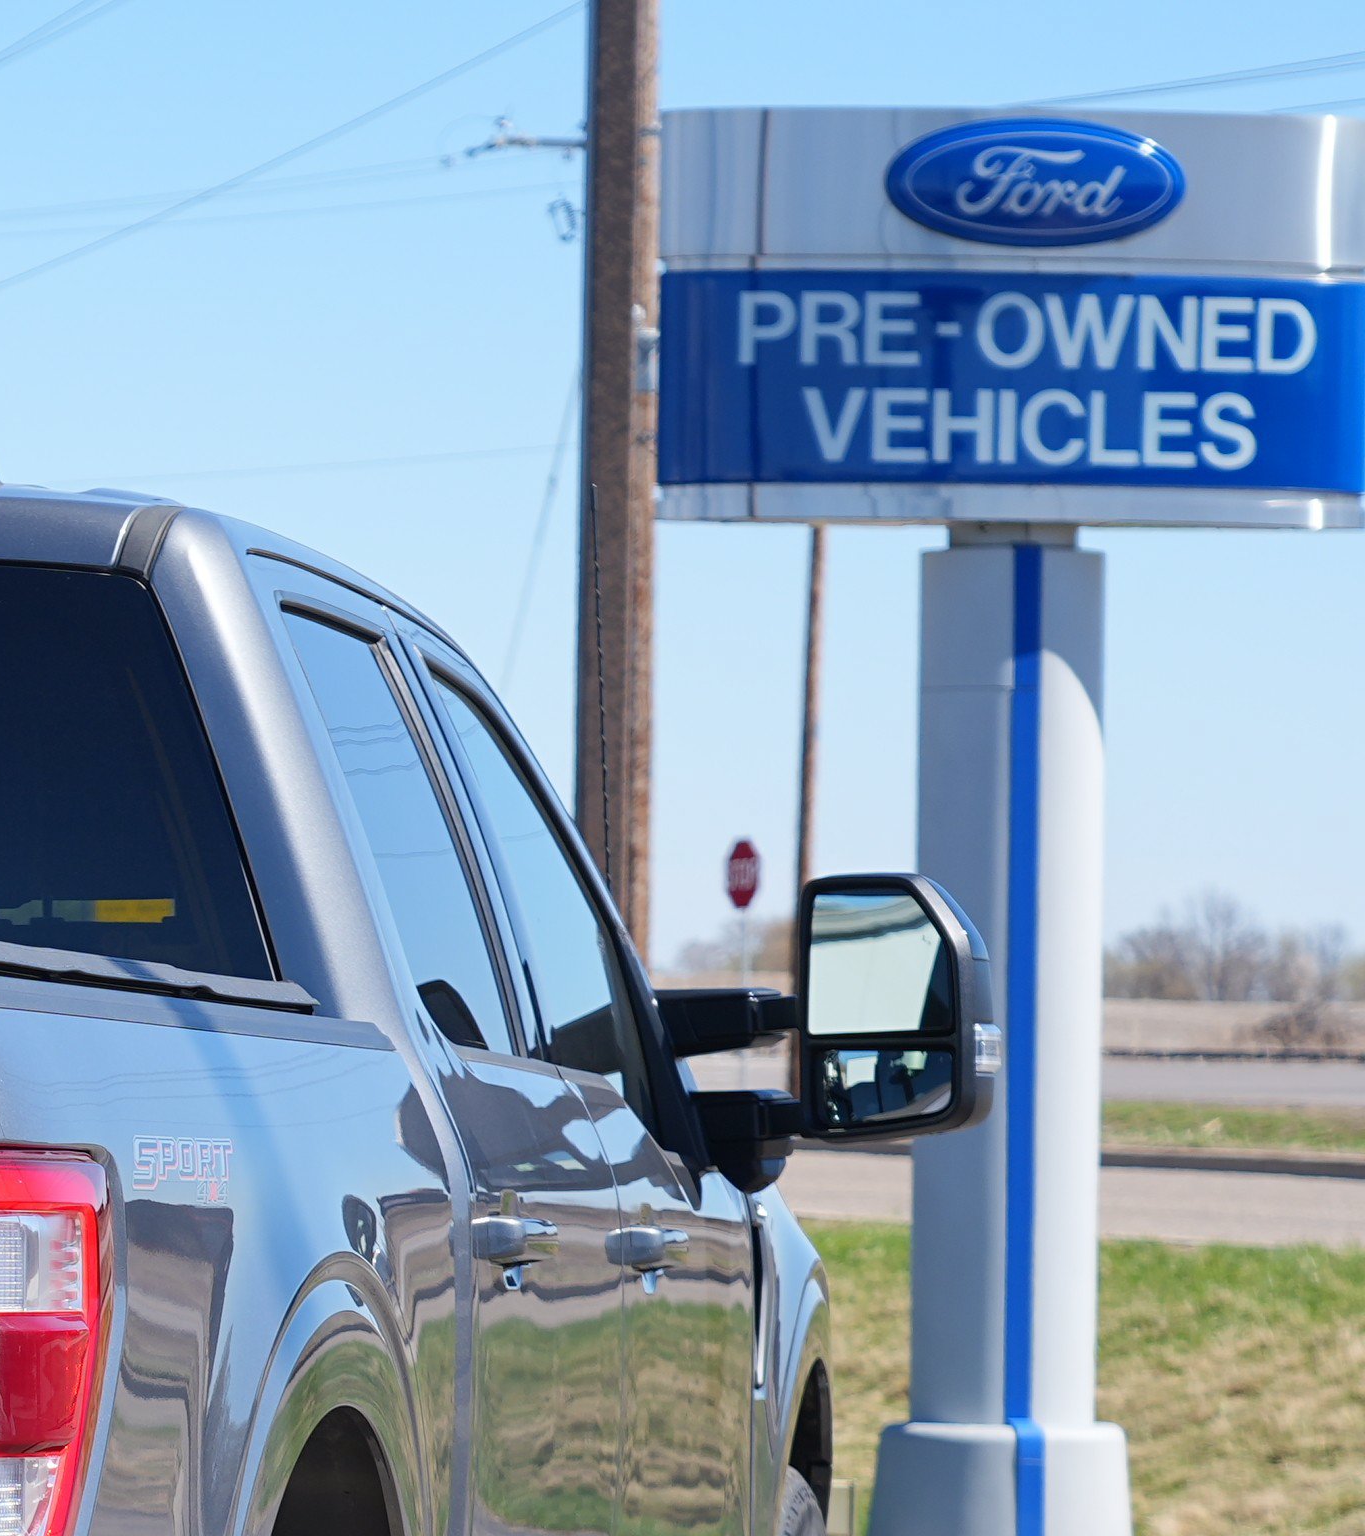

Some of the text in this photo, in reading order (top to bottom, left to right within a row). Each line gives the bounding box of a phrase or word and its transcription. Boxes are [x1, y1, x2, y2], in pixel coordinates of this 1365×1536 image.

[956, 144, 1125, 217] Ford
[738, 291, 1318, 375] PRE-OWNED
[802, 387, 1258, 469] VEHICLES
[730, 858, 756, 890] STOP
[132, 1135, 233, 1191] SPORT
